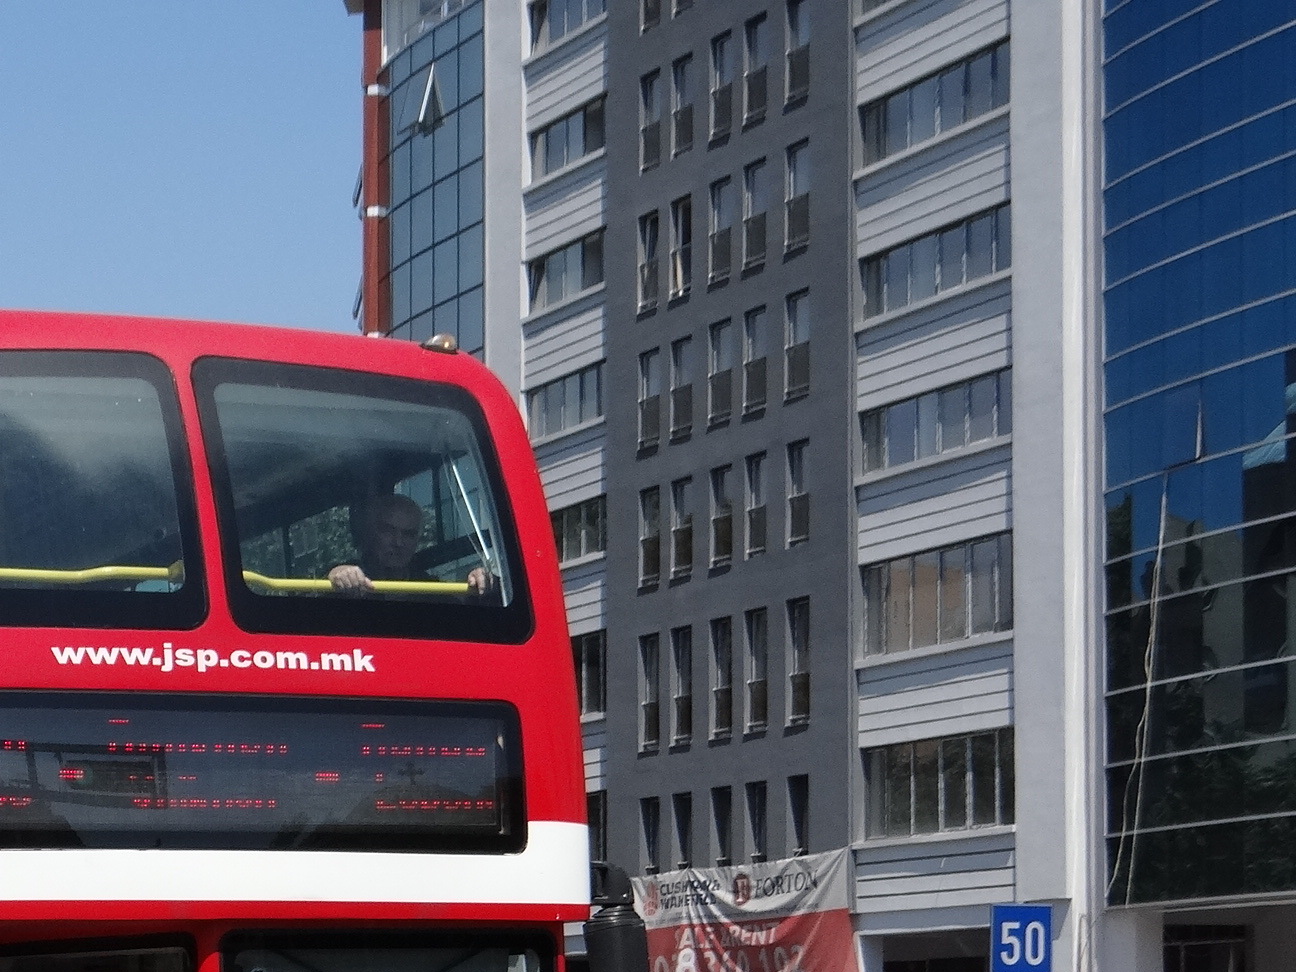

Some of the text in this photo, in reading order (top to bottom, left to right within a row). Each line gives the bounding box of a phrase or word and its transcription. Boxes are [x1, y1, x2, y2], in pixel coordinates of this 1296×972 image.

[51, 642, 376, 673] www.jsp.com.mk
[754, 870, 819, 899] FORTON
[1000, 921, 1045, 967] 50
